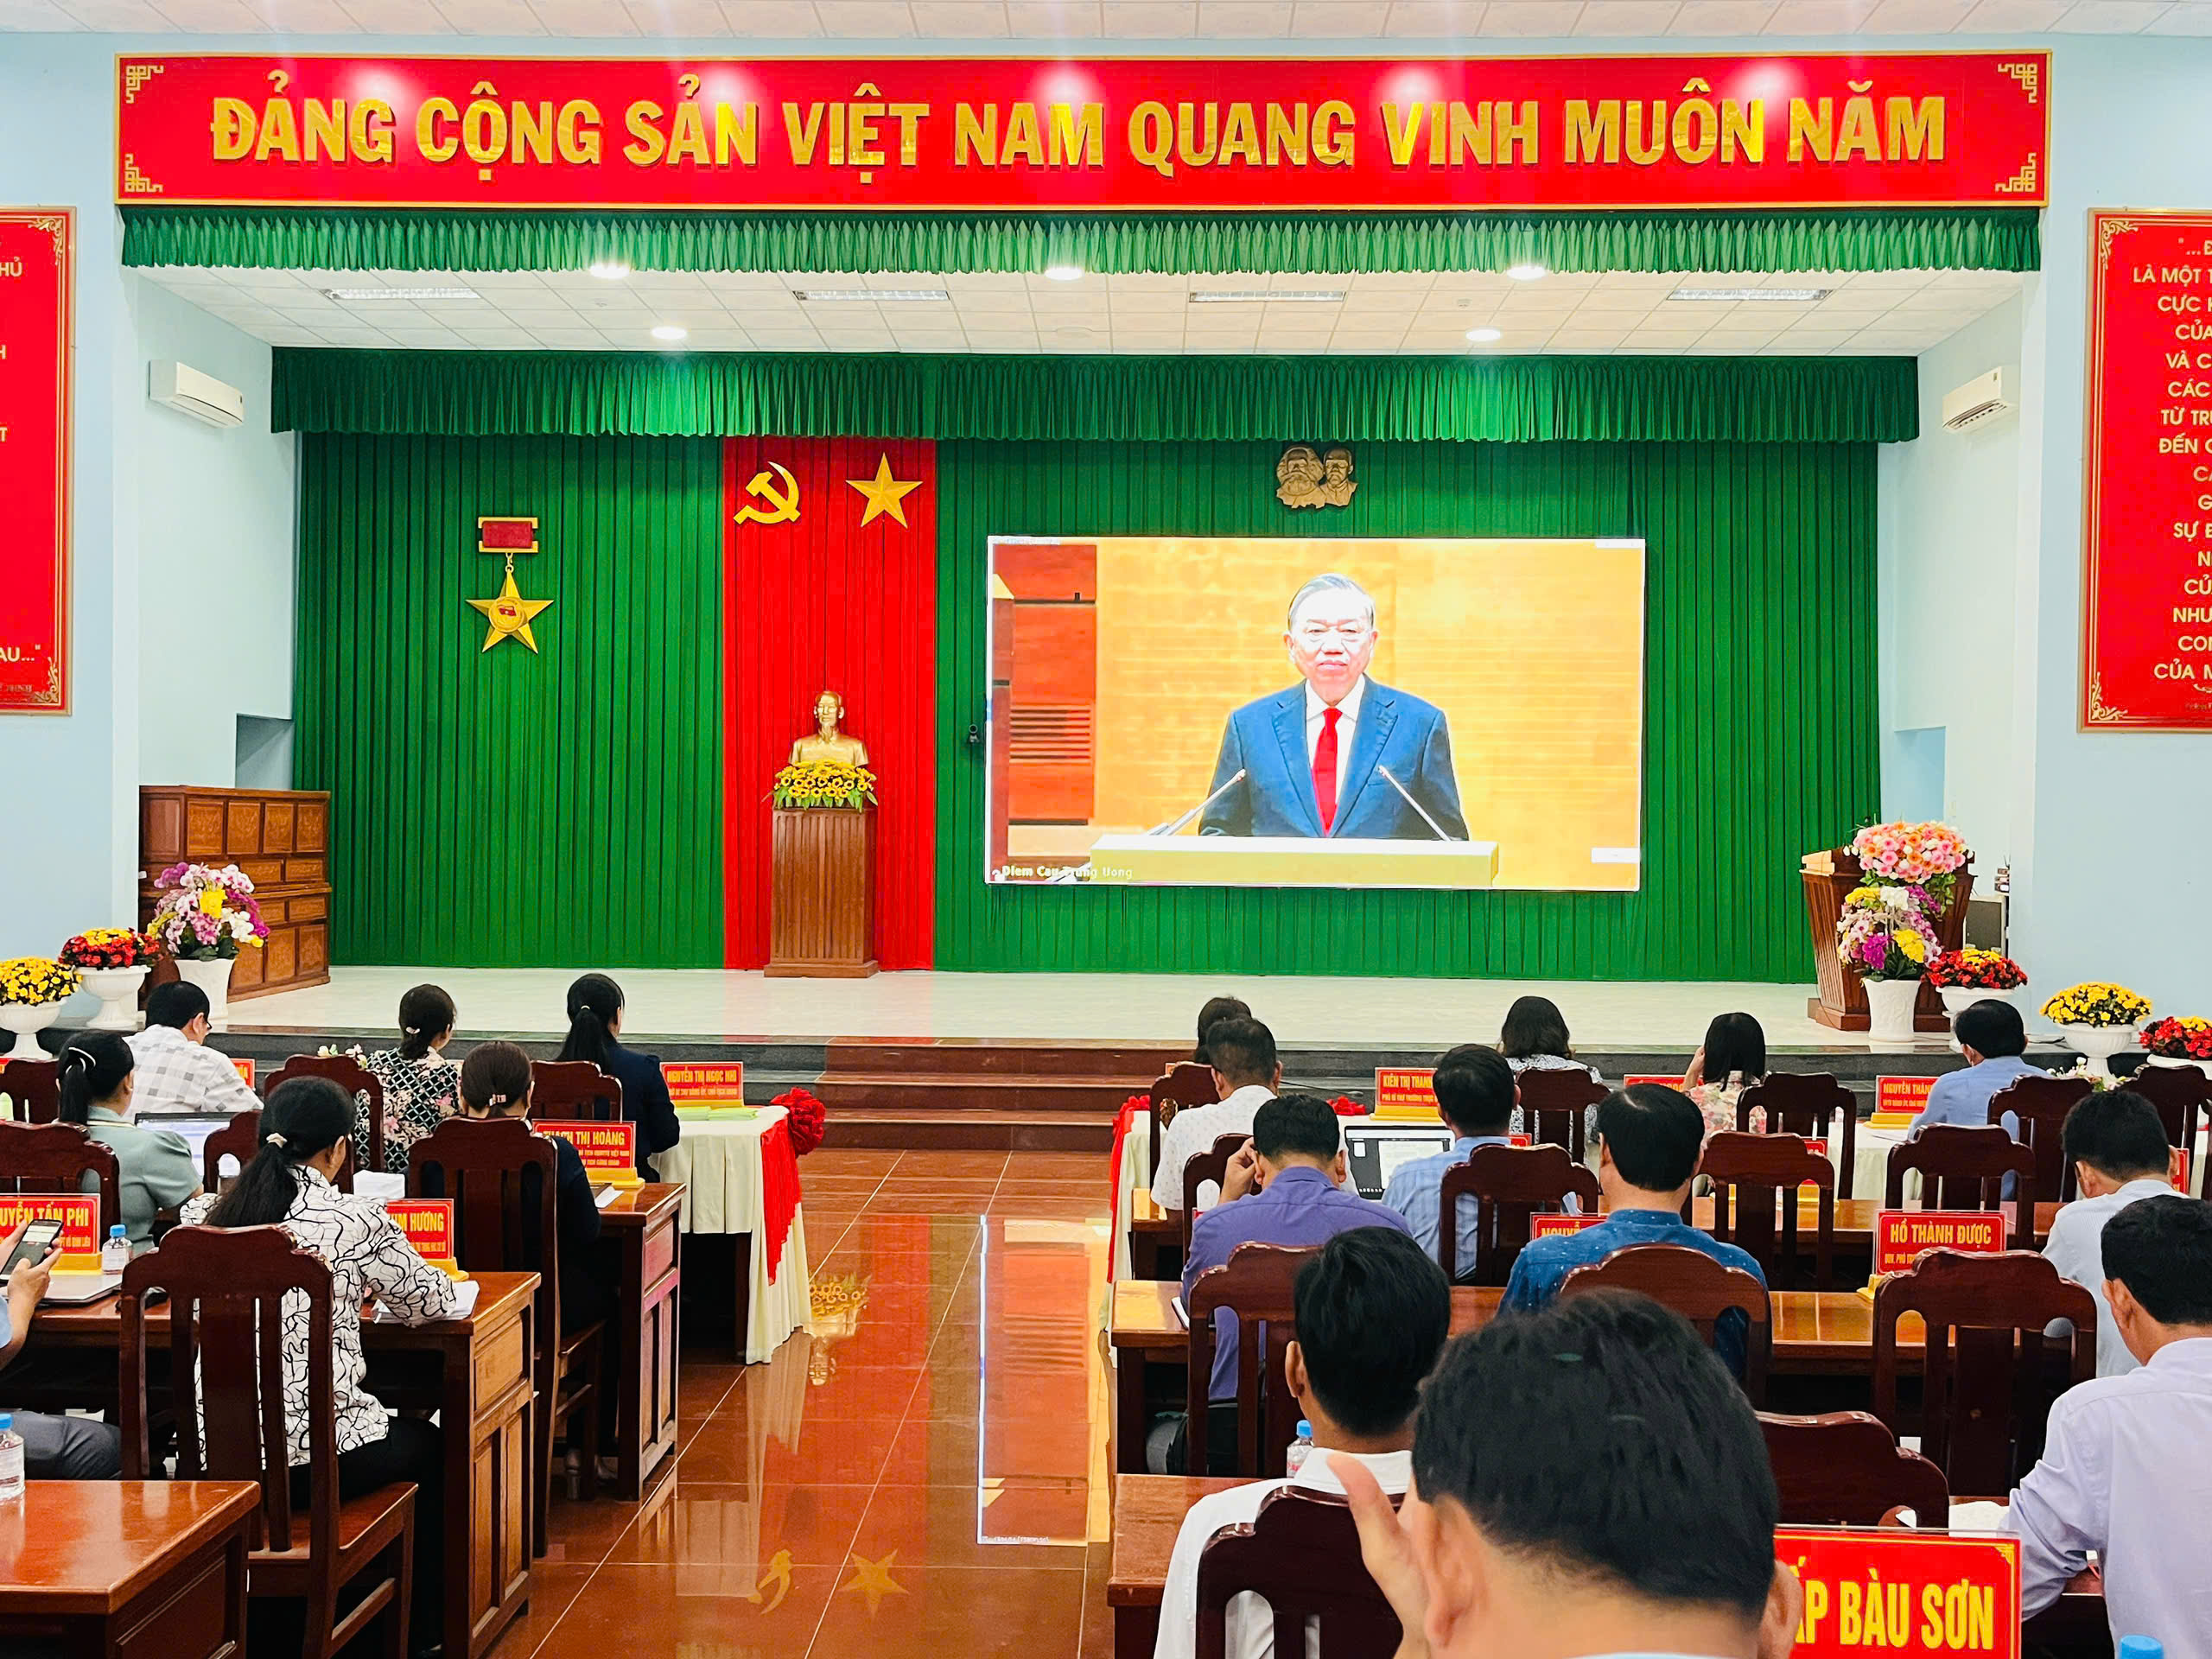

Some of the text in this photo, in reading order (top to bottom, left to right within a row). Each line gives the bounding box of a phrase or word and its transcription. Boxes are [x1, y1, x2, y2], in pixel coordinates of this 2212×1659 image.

[211, 70, 1946, 183] ĐẢNG CỘNG SẢN VIỆT NAM QUANG VINH MUÔN NĂM
[2133, 264, 2156, 283] LÀ
[2161, 264, 2202, 287] MỘT
[2158, 294, 2201, 315] CỰC
[2175, 318, 2212, 340] CỦA
[2165, 349, 2190, 369] VÀ
[2167, 378, 2210, 397] CÁC
[2160, 407, 2185, 425] TỪ
[2158, 432, 2198, 454] ĐẾN
[2173, 520, 2199, 543] SỰ
[2153, 658, 2196, 680] CỦA
[575, 1131, 590, 1147] THỊ
[592, 1128, 626, 1147] HOÀNG
[67, 1208, 89, 1227] PHI
[410, 1211, 445, 1232] HƯƠNG
[1911, 1220, 1954, 1244] THÀNH
[1956, 1222, 1992, 1249] ĐƯỢC
[1840, 1567, 1910, 1648] BÀU
[1921, 1578, 1994, 1650] SƠN
